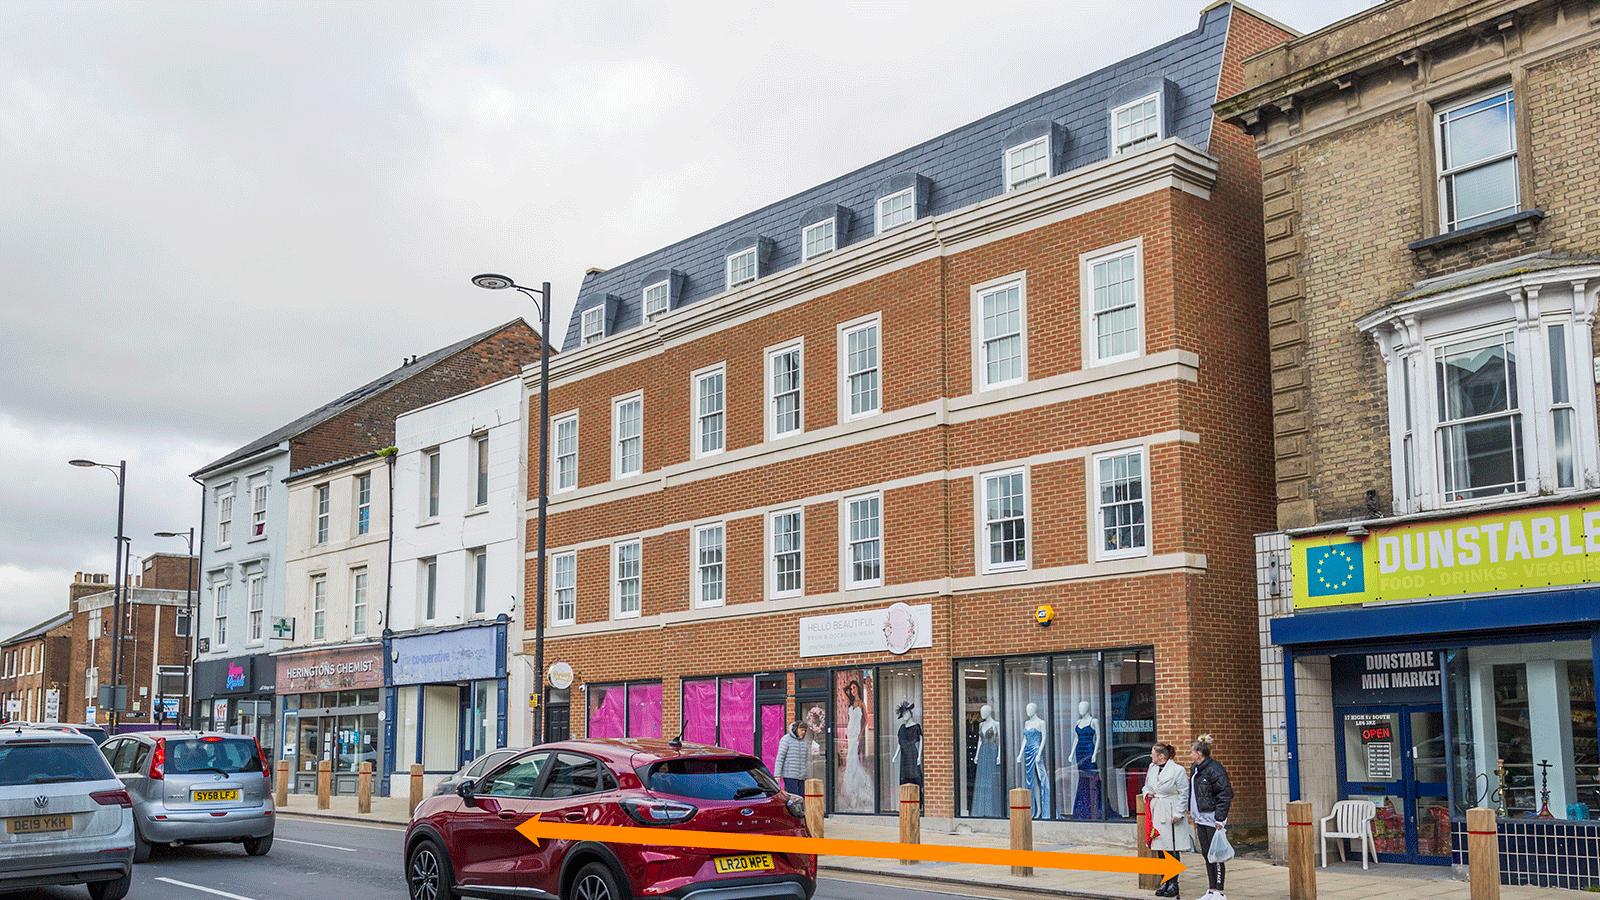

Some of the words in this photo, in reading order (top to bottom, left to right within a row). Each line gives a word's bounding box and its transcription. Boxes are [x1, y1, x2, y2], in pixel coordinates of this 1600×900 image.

[1378, 511, 1600, 574] DUNSTABLE
[1380, 575, 1425, 591] FOOD
[1440, 567, 1507, 586] DRINKS
[1523, 557, 1600, 578] VEGGIES
[808, 622, 831, 632] HELLO
[833, 618, 874, 630] BEAUTIFUL
[831, 631, 857, 640] OCCASION
[412, 651, 450, 666] co-operative
[1366, 651, 1434, 671] DUNSTABLE
[287, 664, 335, 679] HERINGTONS
[336, 660, 374, 674] CHEMIST
[1362, 672, 1389, 689] MINI
[1391, 670, 1440, 688] MARKET
[1362, 728, 1390, 739] OPEN
[197, 791, 218, 800] SY58
[220, 791, 236, 800] LFJ
[14, 819, 40, 831] DE19
[43, 817, 66, 829] YKH
[719, 857, 747, 871] LR20
